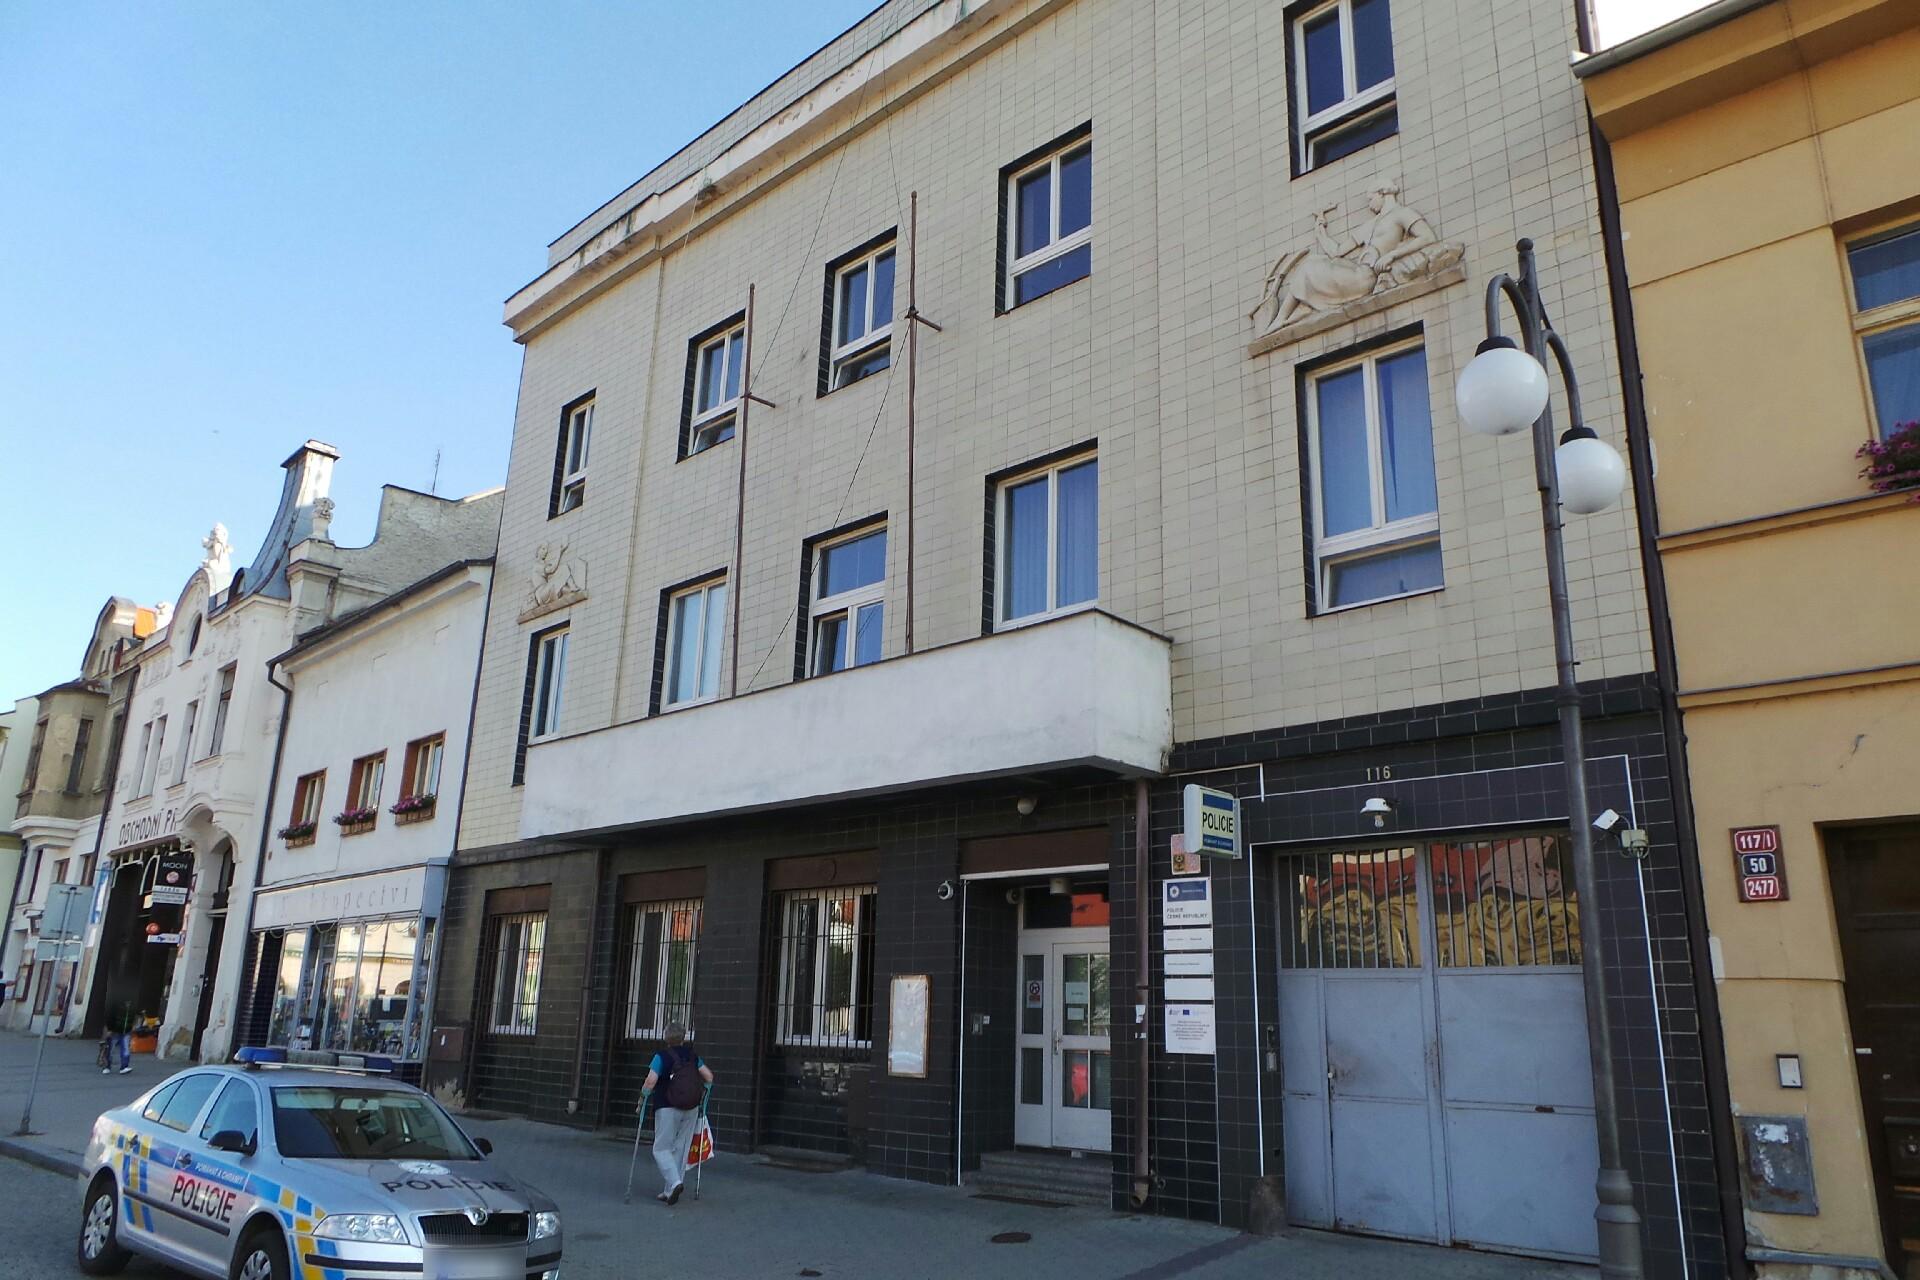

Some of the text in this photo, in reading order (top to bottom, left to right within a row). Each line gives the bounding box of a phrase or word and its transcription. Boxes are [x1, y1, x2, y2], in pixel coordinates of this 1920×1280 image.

[1366, 765, 1391, 781] 116
[119, 808, 164, 846] OBCHODNÍ
[1202, 811, 1234, 833] POLICIE
[162, 861, 188, 870] MOON
[1750, 857, 1767, 873] 50
[1748, 880, 1774, 896] 2477
[381, 1179, 516, 1193] POLICIE
[170, 1175, 237, 1223] POLICIE
